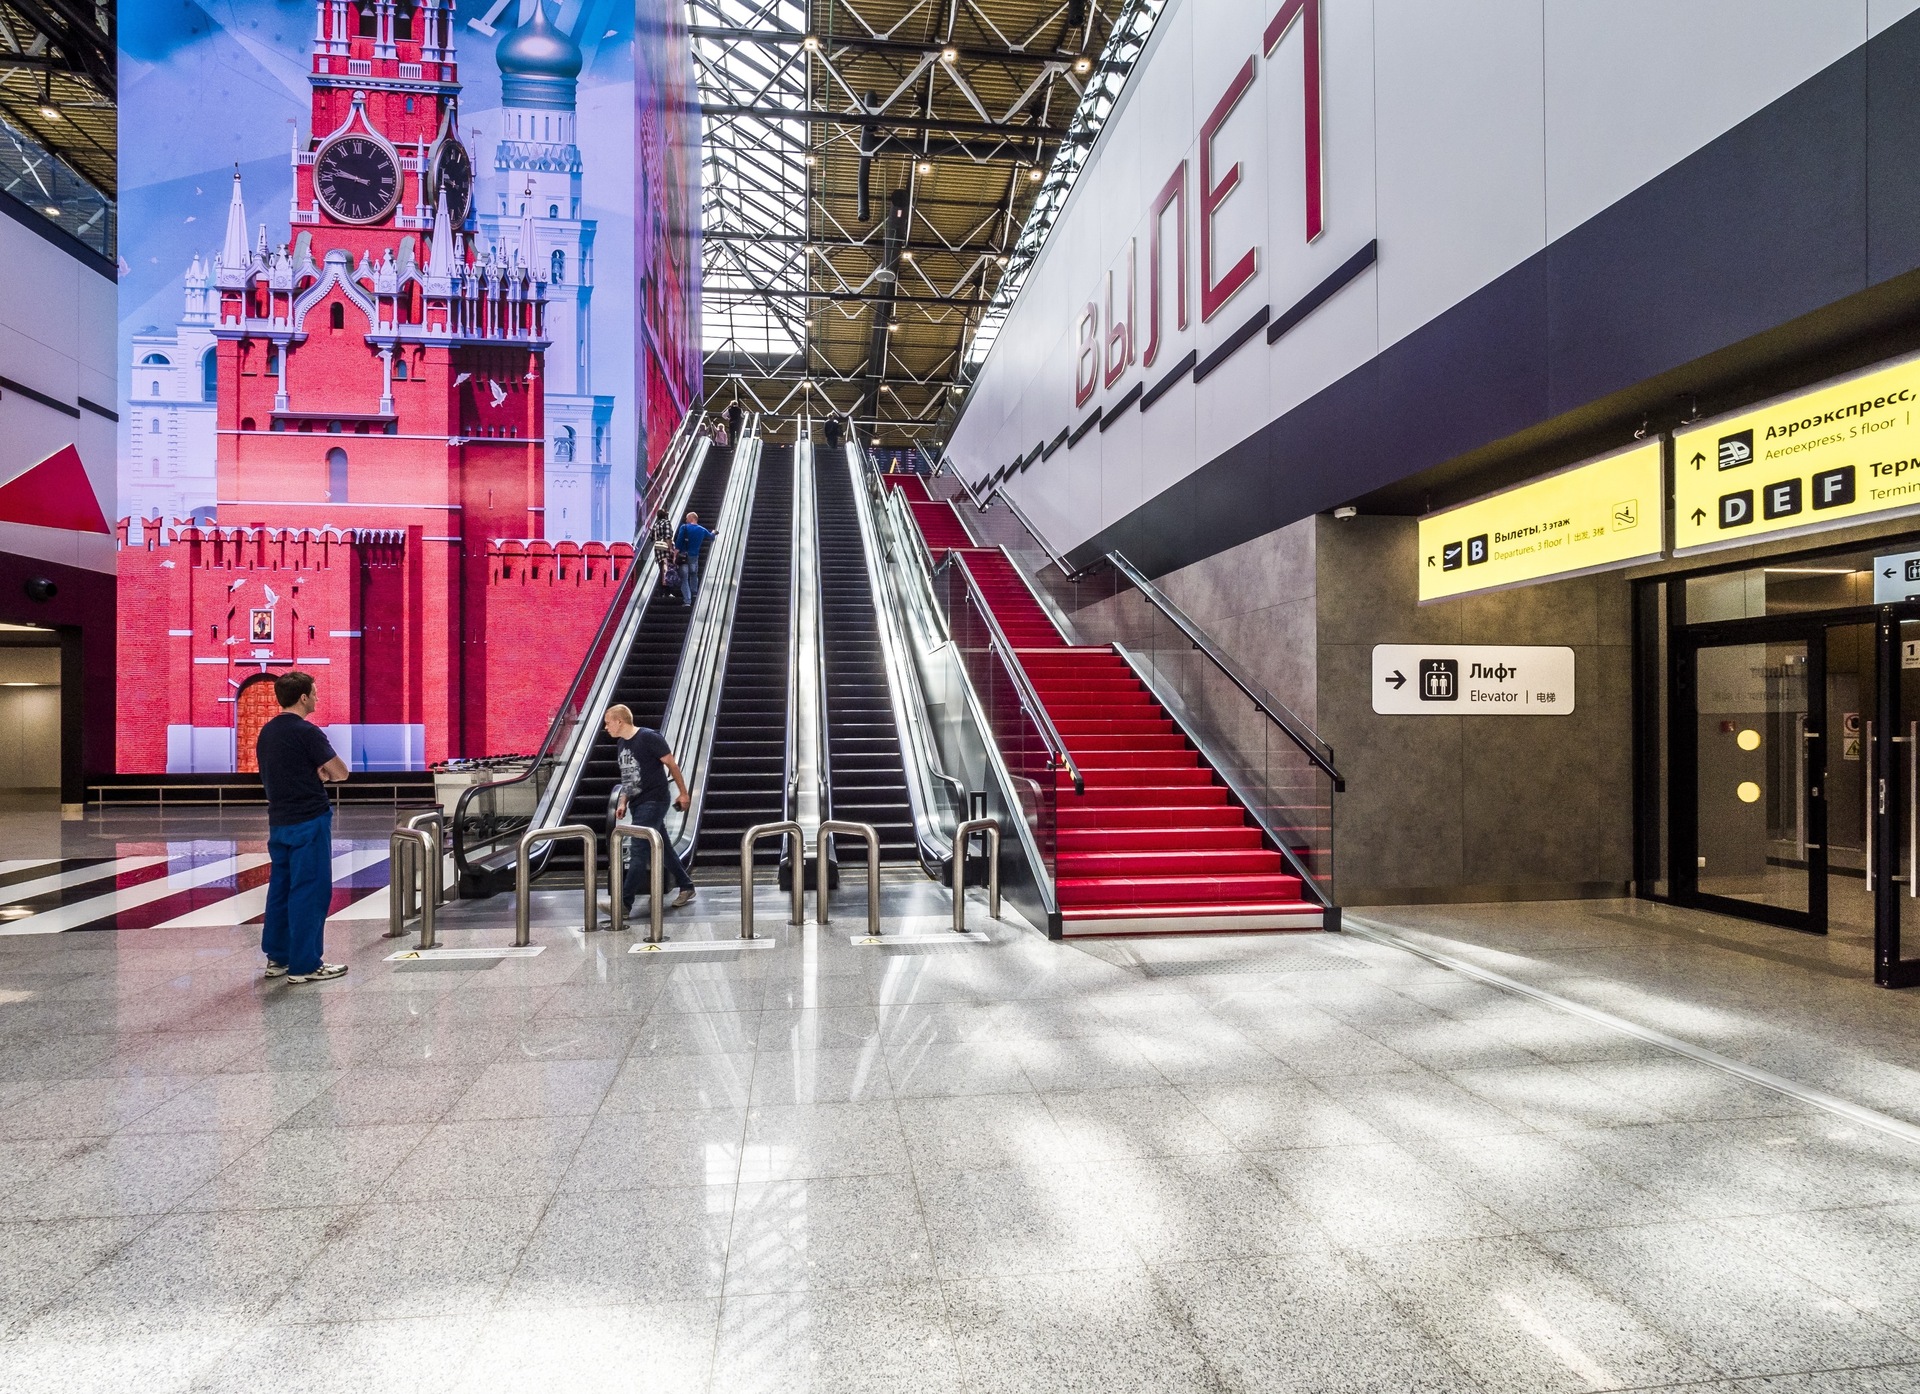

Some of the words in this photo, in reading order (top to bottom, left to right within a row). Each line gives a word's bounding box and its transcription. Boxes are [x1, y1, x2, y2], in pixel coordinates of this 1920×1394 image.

[1075, 0, 1324, 408] ВЫЛЕТ
[1765, 389, 1917, 440] Аэроэкспресс,
[1765, 432, 1846, 460] Aeroexpress,
[1861, 418, 1896, 435] floor
[1725, 498, 1747, 523] D
[1773, 486, 1791, 513] E
[1824, 474, 1843, 503] F
[1494, 525, 1541, 544] Вылеты,
[1549, 518, 1570, 530] этаж
[1494, 546, 1536, 561] Departures,
[1543, 538, 1562, 549] floor
[1470, 662, 1517, 683] Лифт
[1470, 690, 1518, 702] Elevator
[1536, 692, 1556, 703] 电梯
